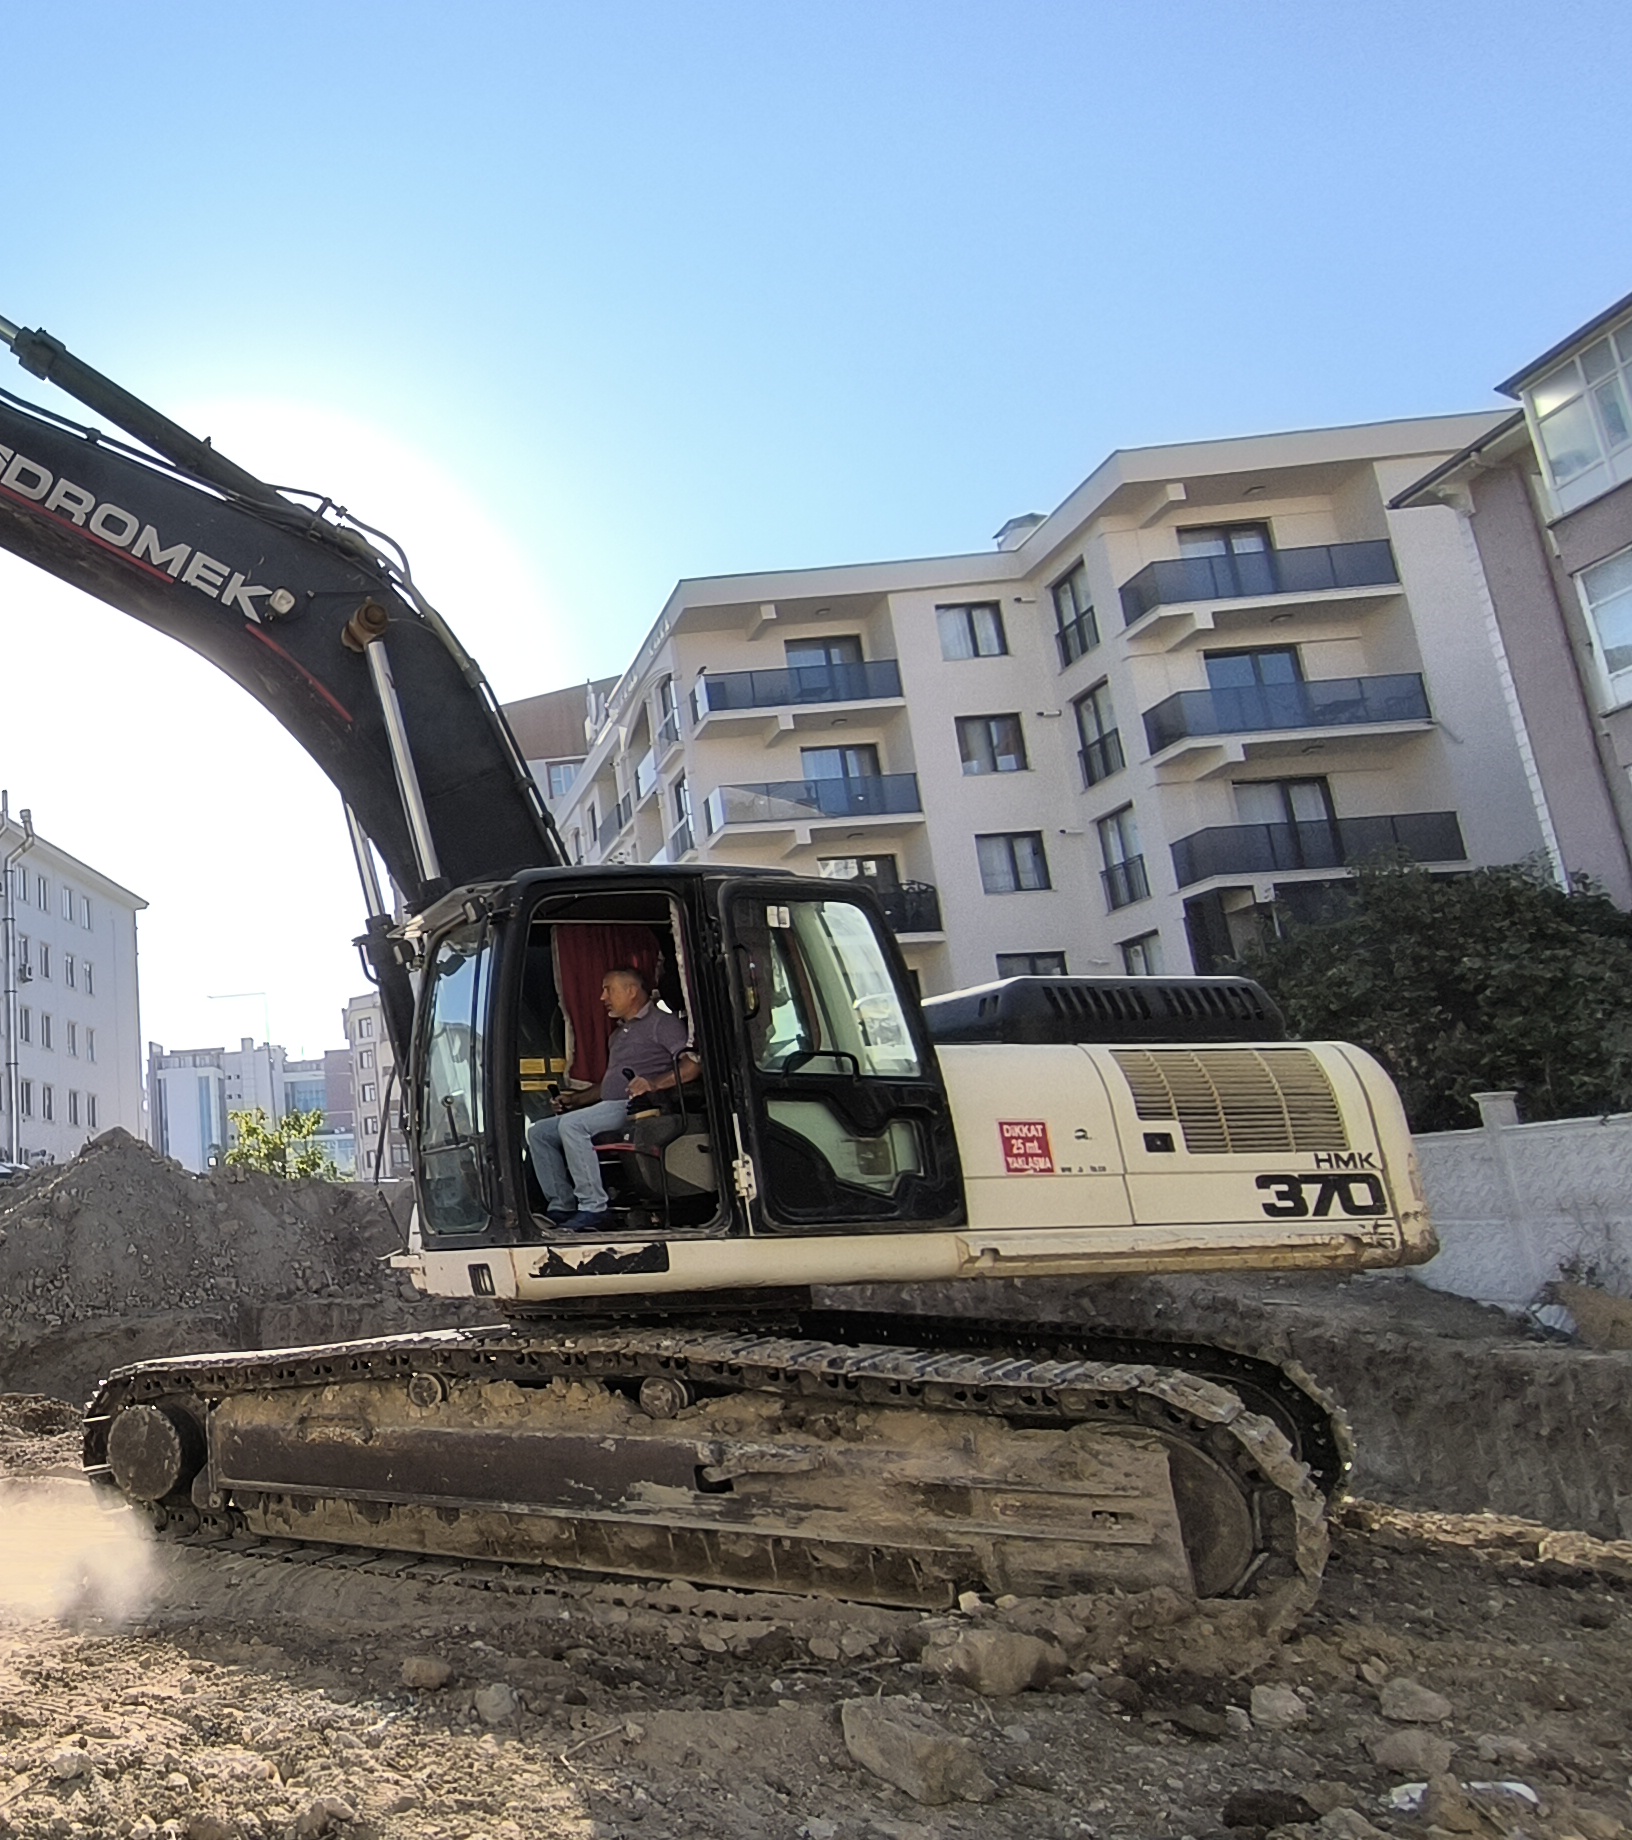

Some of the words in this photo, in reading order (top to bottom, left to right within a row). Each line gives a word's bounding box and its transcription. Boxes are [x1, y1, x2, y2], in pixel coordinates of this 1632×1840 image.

[1011, 1139, 1024, 1154] 25
[1314, 1152, 1380, 1169] HMK
[1255, 1173, 1387, 1217] 370
